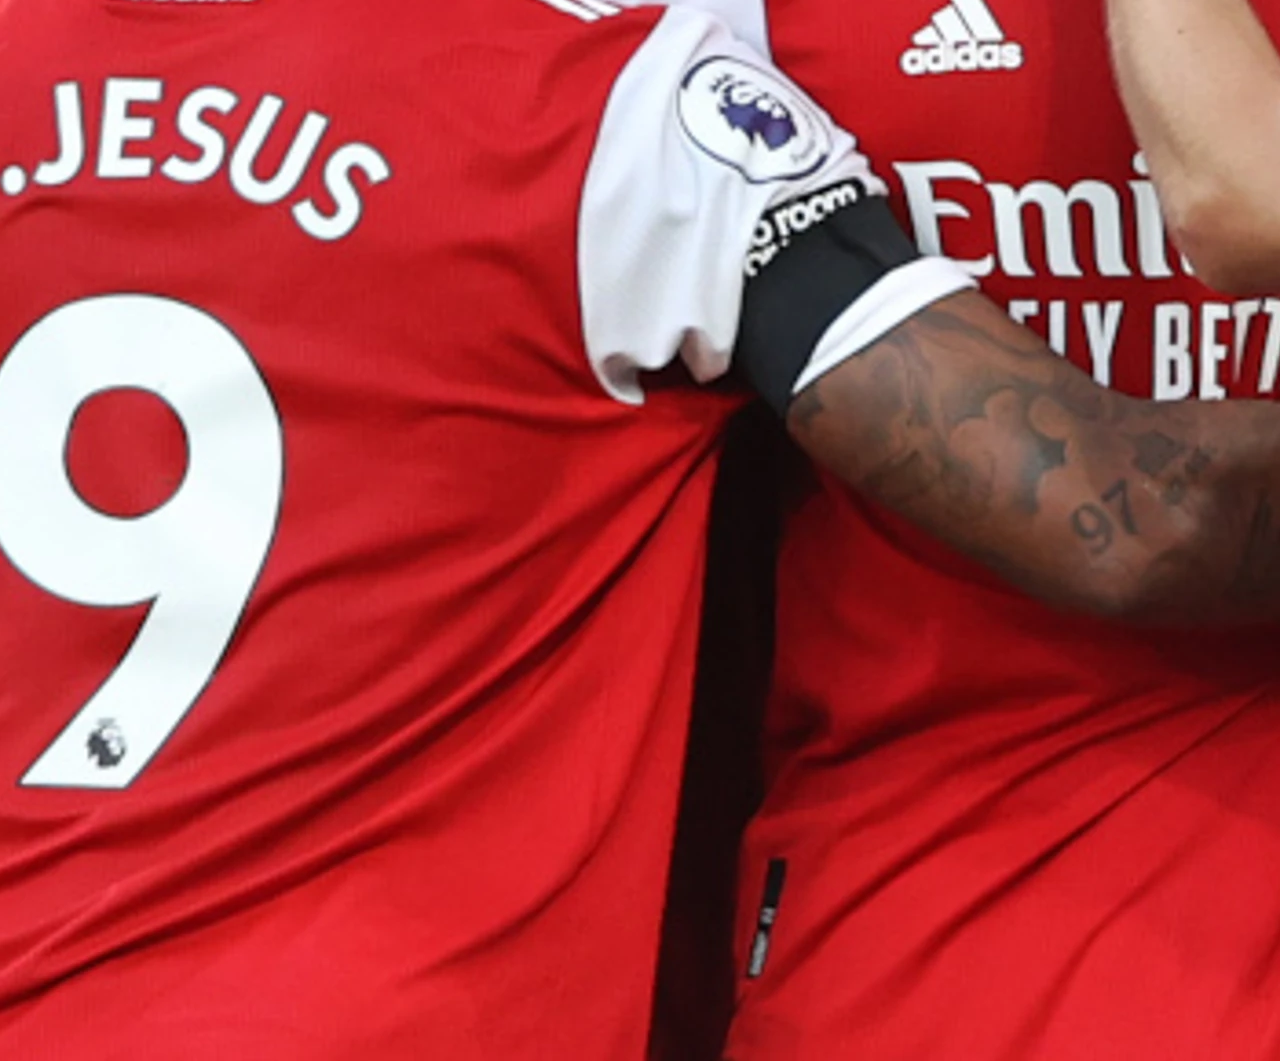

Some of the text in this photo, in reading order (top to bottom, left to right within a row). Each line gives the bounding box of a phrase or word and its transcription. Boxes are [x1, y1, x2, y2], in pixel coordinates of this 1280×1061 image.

[899, 40, 1024, 76] adidas
[774, 183, 858, 239] room
[1072, 478, 1139, 556] 97
